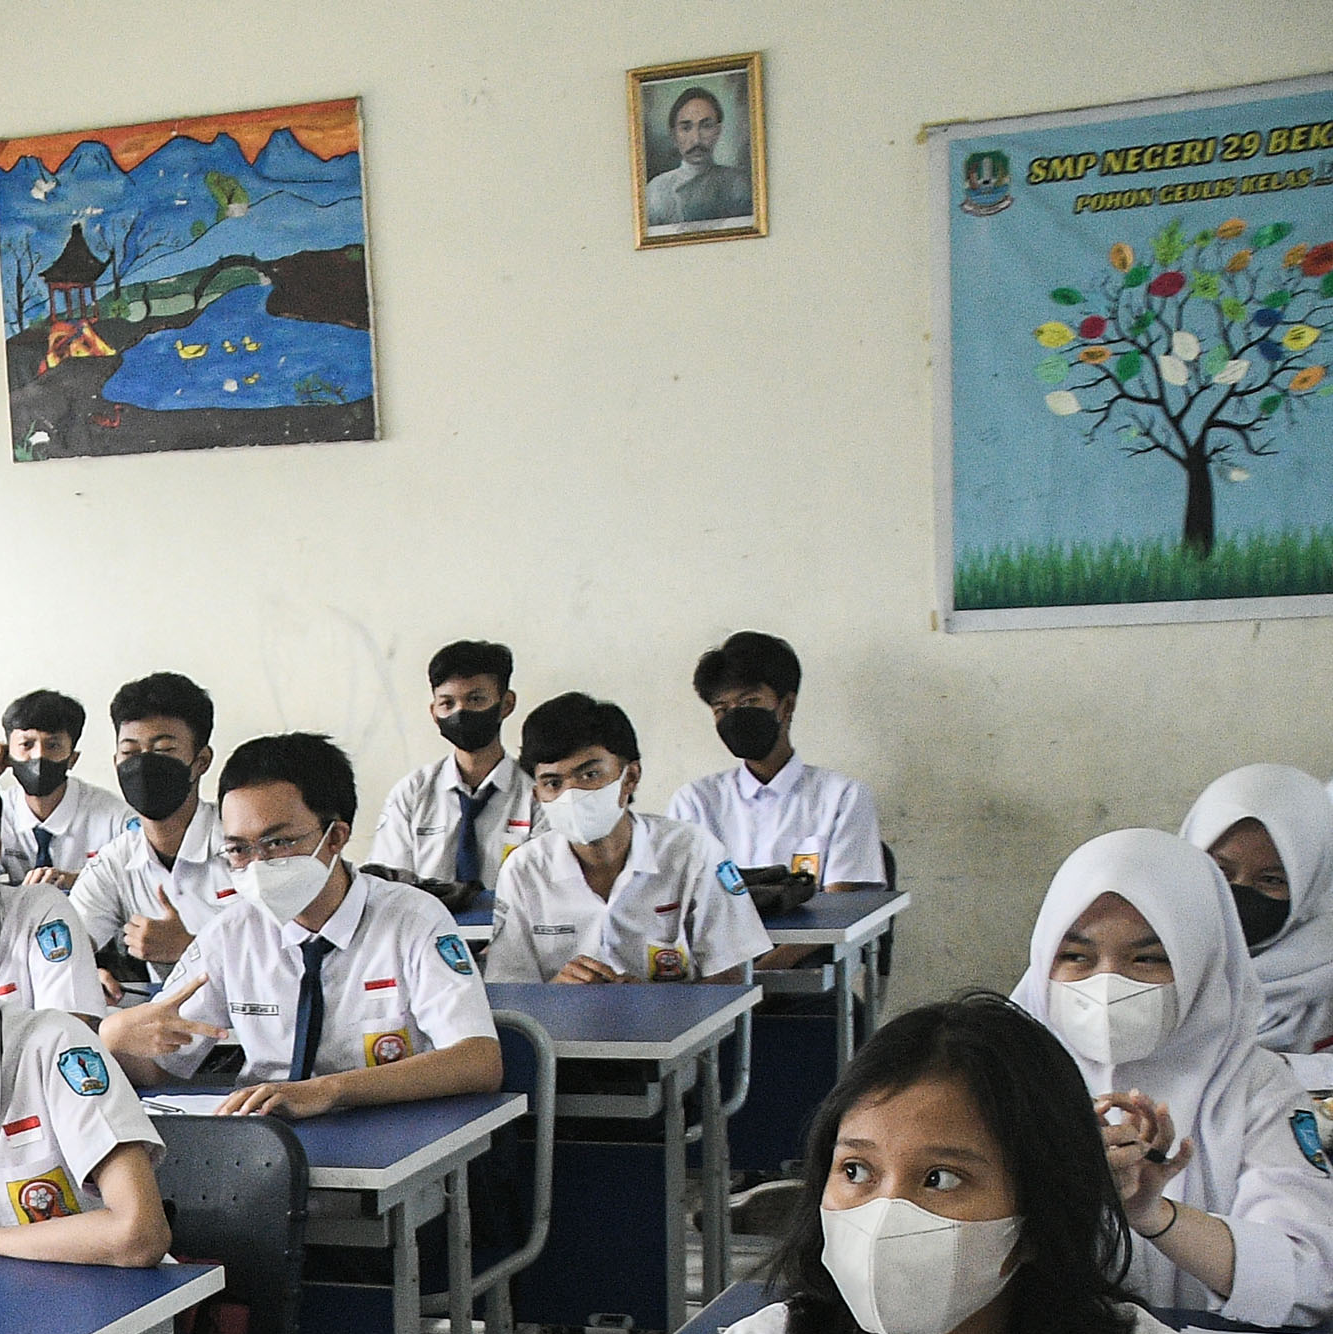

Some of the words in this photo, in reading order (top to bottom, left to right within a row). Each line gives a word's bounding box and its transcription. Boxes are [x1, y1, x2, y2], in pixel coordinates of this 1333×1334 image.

[1027, 152, 1097, 185] SMP
[1100, 136, 1217, 176] NEGERI
[1220, 130, 1261, 162] 29
[1074, 188, 1157, 214] POHON
[1240, 167, 1314, 195] KELAS
